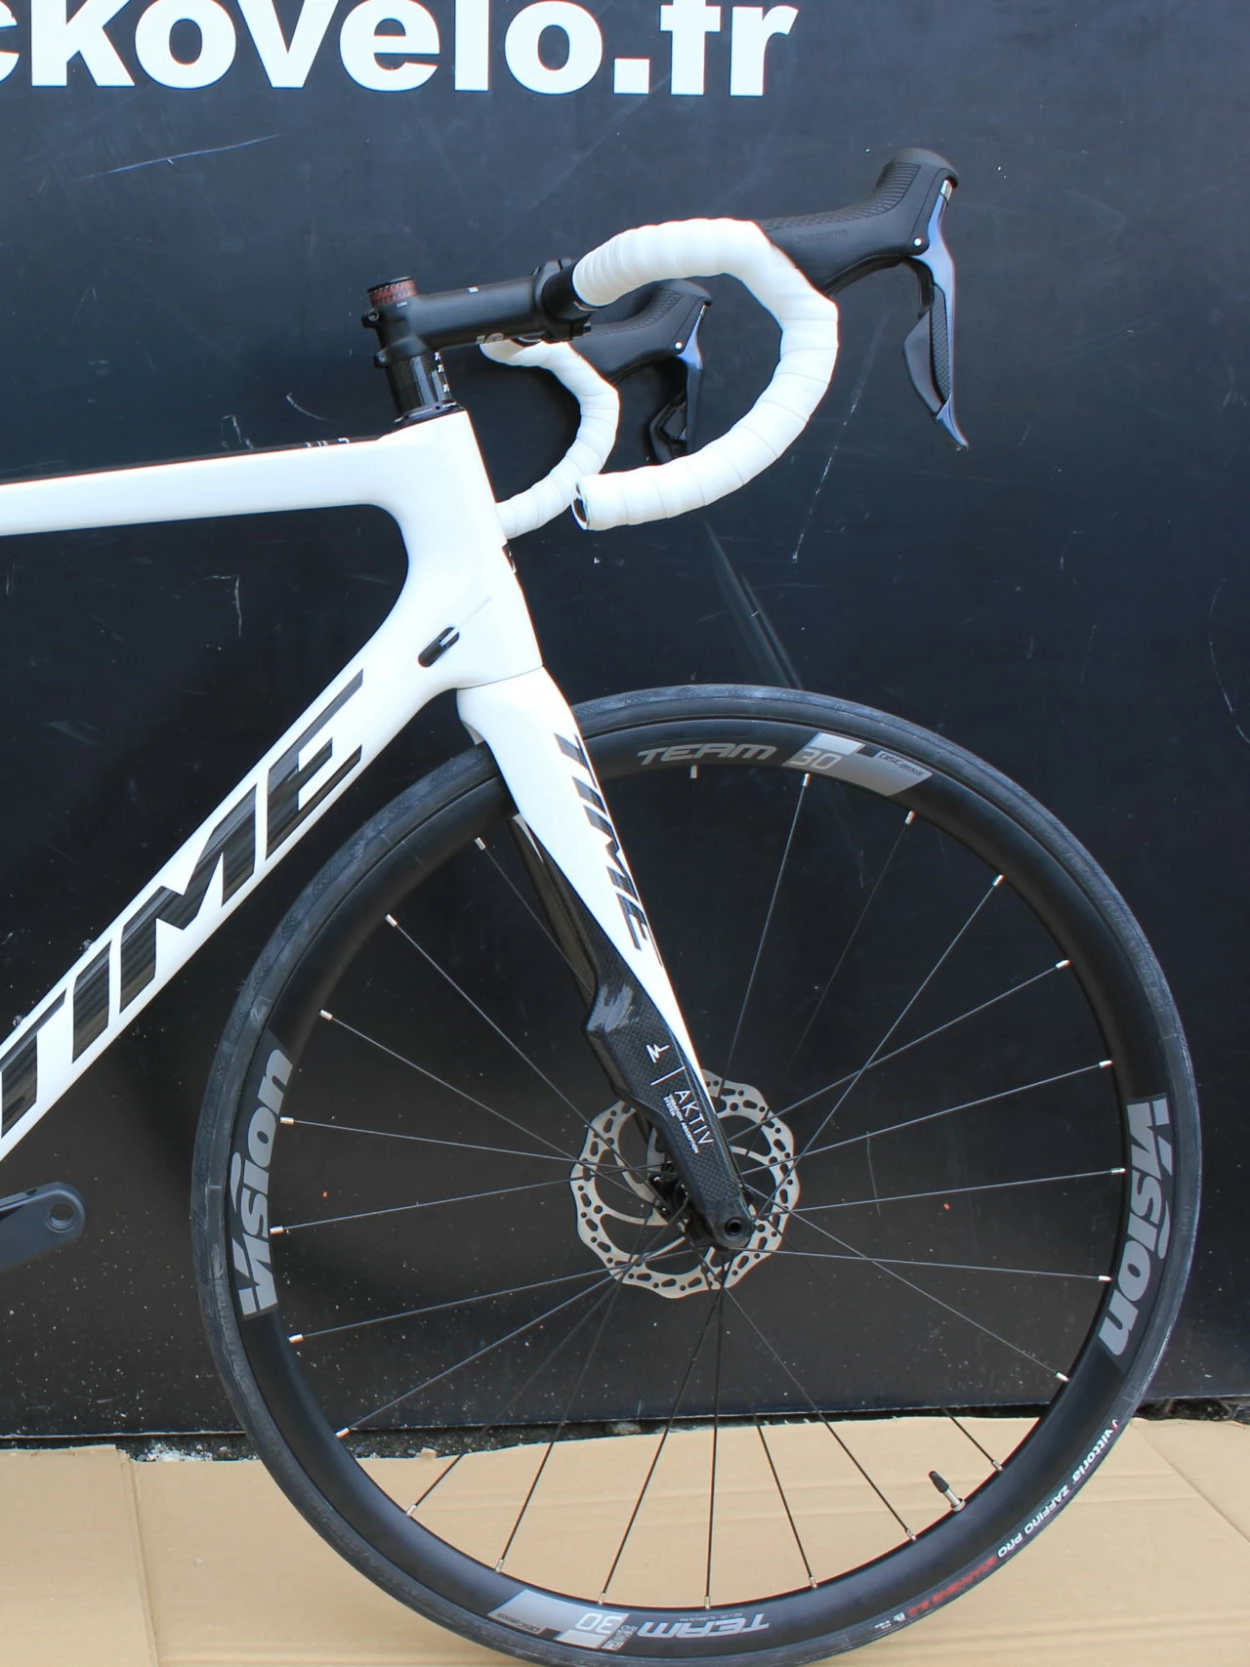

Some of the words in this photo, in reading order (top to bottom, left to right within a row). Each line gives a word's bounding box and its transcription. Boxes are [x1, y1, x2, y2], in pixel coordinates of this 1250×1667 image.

[637, 743, 777, 766] TEAM
[792, 748, 842, 770] 30
[554, 733, 663, 968] TIME
[674, 1090, 714, 1144] AKTIV
[232, 1048, 294, 1316] Vision
[1098, 1097, 1175, 1357] Vision
[1072, 1428, 1114, 1483] vittoria
[997, 1532, 1023, 1558] PRO
[575, 1612, 622, 1634] 30
[636, 1613, 770, 1638] TEAM
